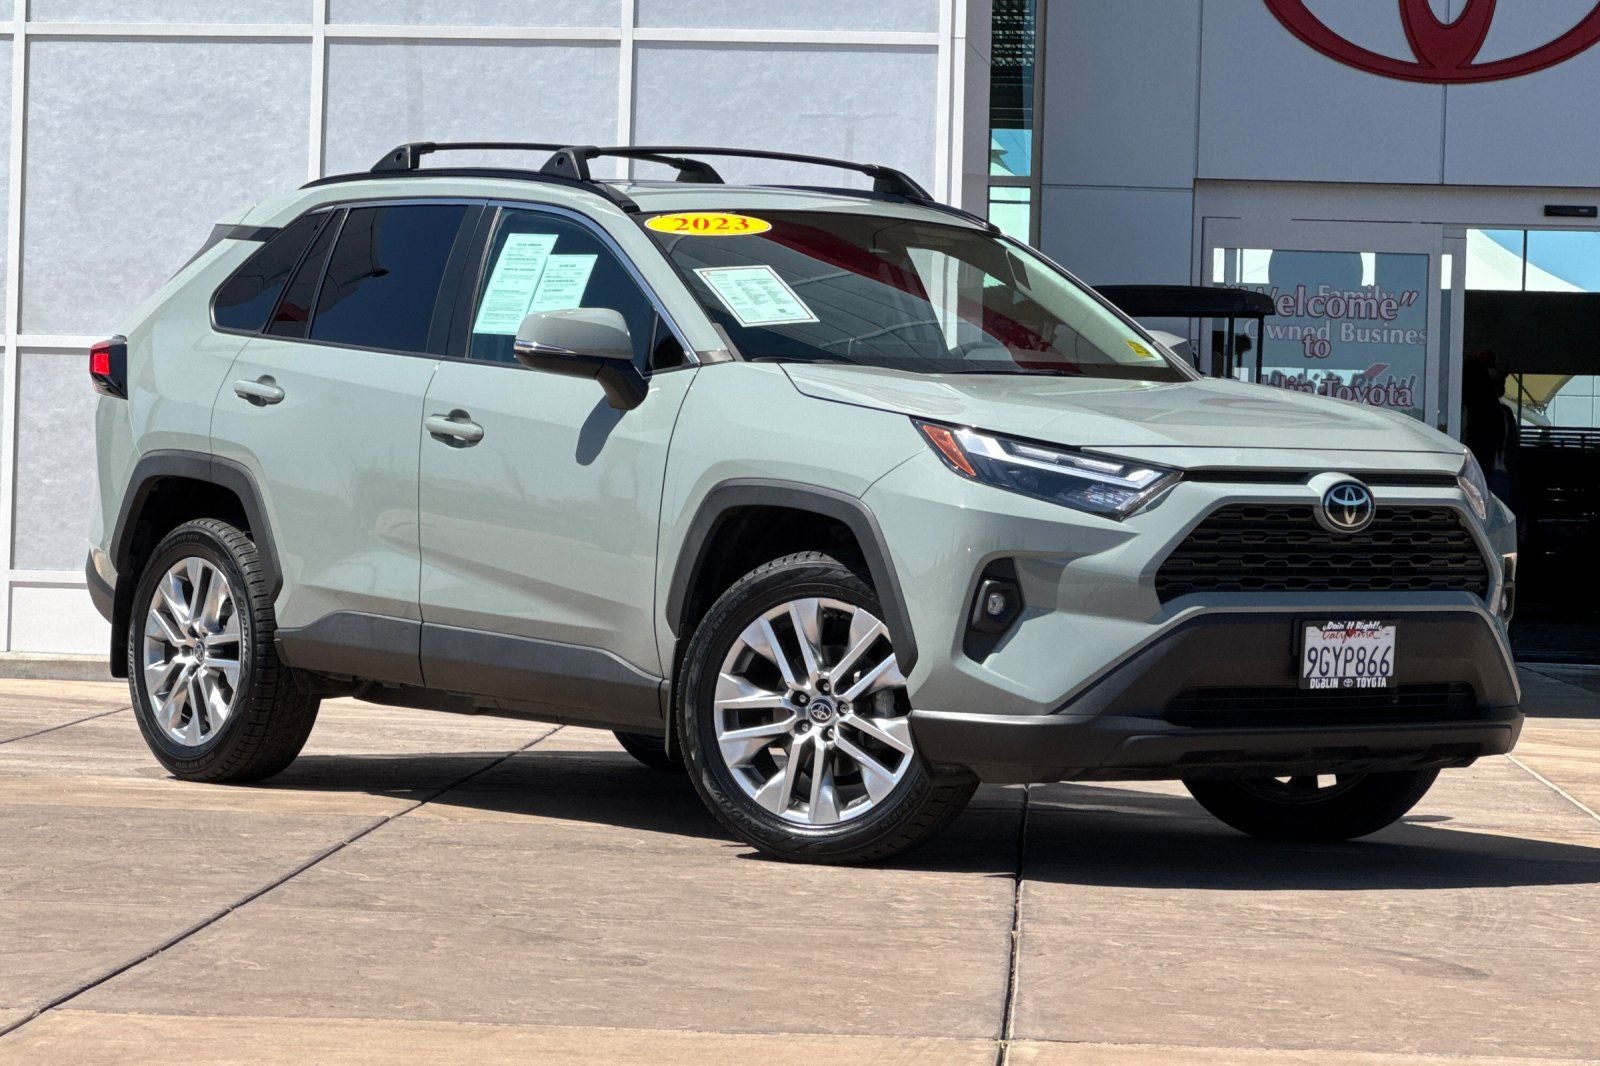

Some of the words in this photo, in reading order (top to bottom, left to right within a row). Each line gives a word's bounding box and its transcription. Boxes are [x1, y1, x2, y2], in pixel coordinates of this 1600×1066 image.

[672, 216, 750, 231] 2023
[1303, 333, 1332, 358] to
[1306, 646, 1391, 679] 9GYP866
[1310, 678, 1339, 689] DUBLIN
[1356, 677, 1387, 688] TOYOTA
